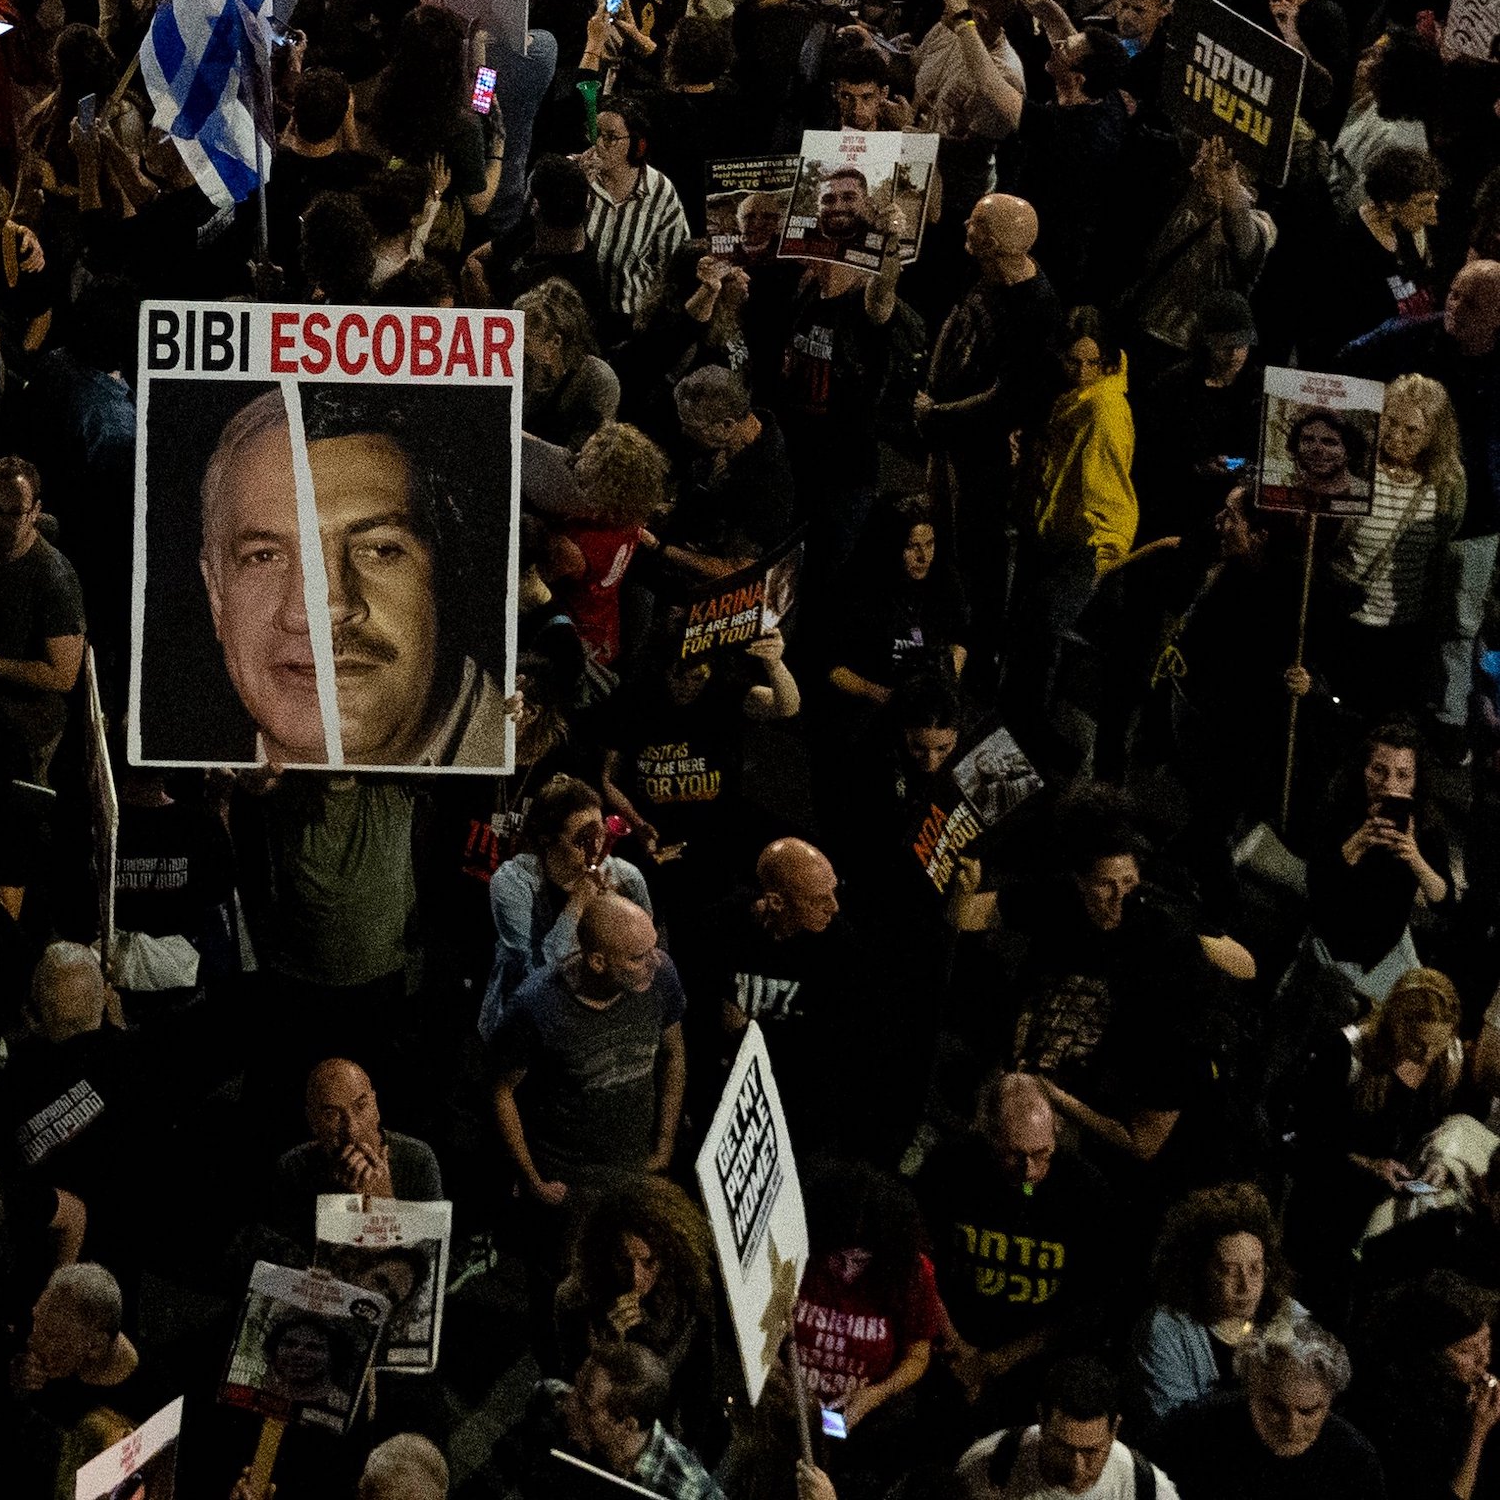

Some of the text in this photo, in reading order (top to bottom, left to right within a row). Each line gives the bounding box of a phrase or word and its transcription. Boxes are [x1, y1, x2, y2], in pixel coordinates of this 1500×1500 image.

[1194, 31, 1275, 107] עסקה
[1184, 63, 1275, 149] עכשיו!
[712, 160, 747, 172] SHLOMO
[711, 244, 734, 254] HIM
[147, 308, 516, 378] BIBI ESCOBAR
[684, 605, 761, 640] WE ARE HERE
[686, 579, 766, 625] KARINA
[680, 619, 758, 658] FOR YOU!
[654, 760, 676, 776] ARE
[677, 757, 707, 774] HERE
[674, 769, 722, 801] YOU!
[912, 802, 949, 868] NOA
[945, 801, 972, 837] HERE
[948, 816, 985, 860] YOU!
[717, 1055, 760, 1183] GET MY
[725, 1082, 769, 1219] PEOPLE
[733, 1117, 776, 1253] HOME!
